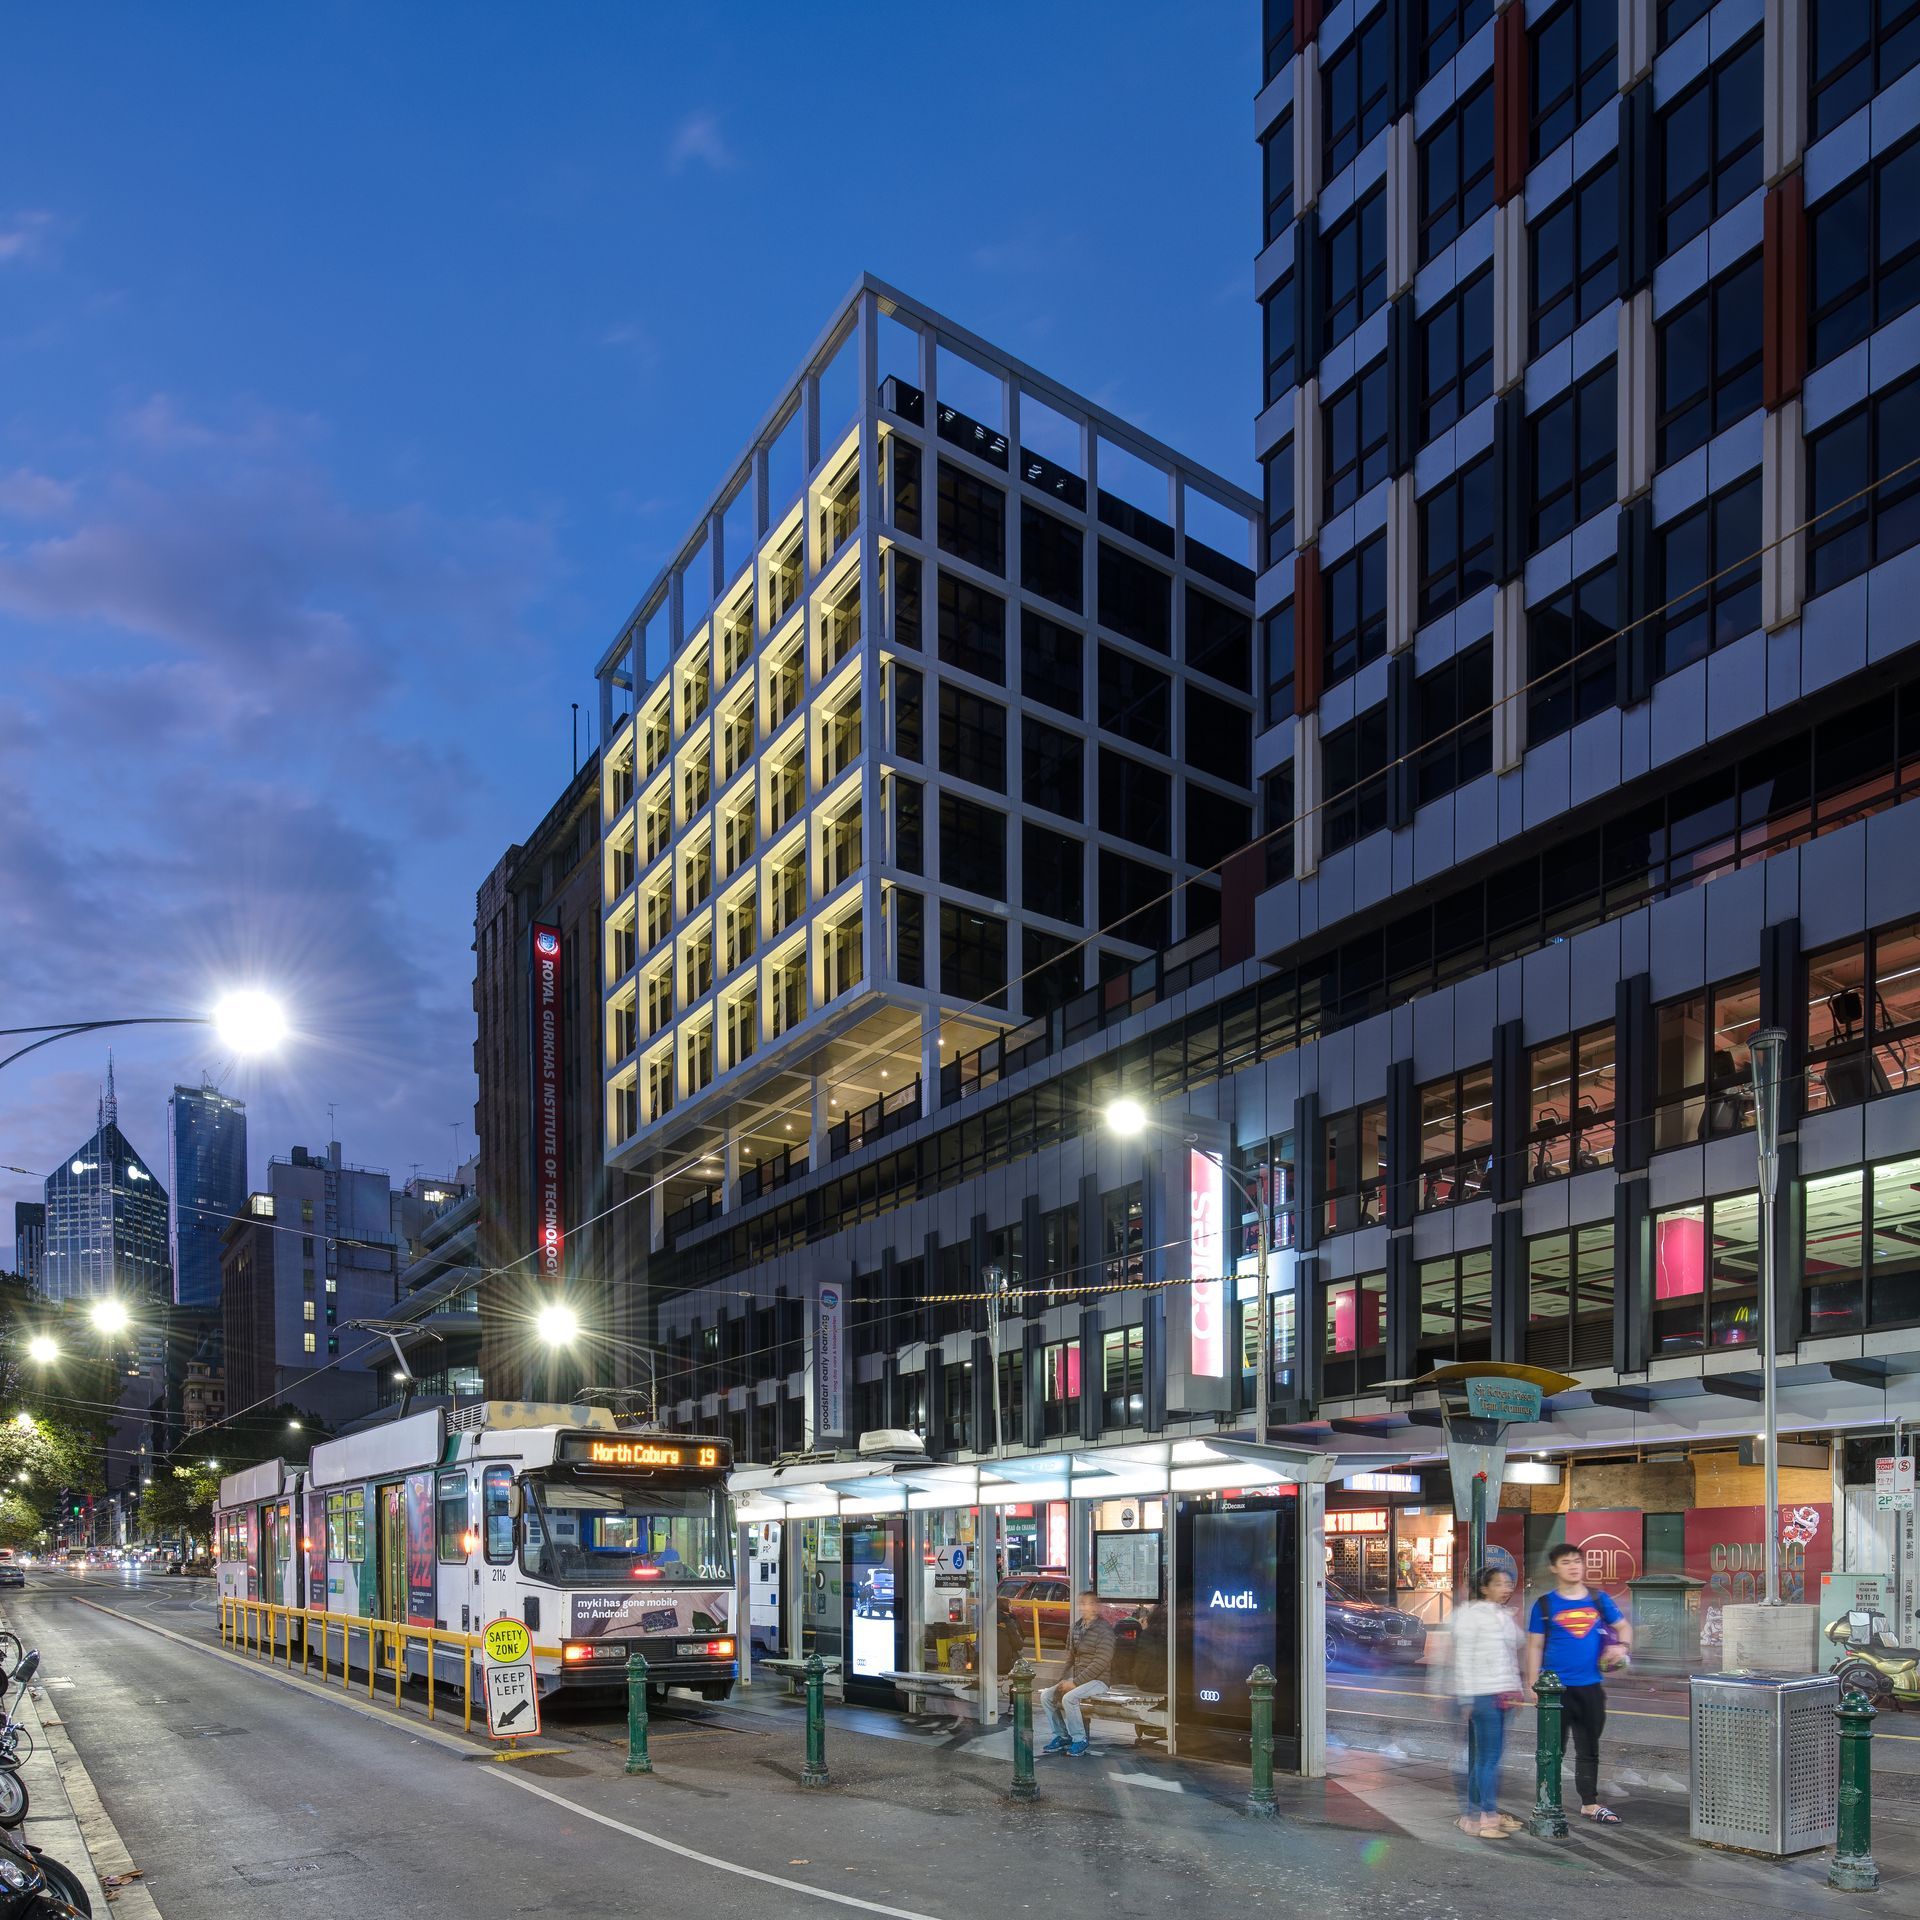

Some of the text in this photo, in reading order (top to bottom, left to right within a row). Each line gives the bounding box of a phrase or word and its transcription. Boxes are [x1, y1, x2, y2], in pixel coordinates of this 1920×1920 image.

[542, 960, 558, 1278] ROYAL GURKHAS INSTITUTE OF TECHNOLOGY
[822, 1314, 830, 1430] goodstart early learning
[593, 1443, 715, 1465] North Coburg 19
[1878, 1496, 1893, 1505] 2P
[492, 1569, 507, 1581] 2116
[698, 1564, 726, 1579] 2116
[577, 1598, 678, 1609] myki has gone mobile
[1210, 1590, 1257, 1609] Audi.
[577, 1609, 629, 1619] on Android
[490, 1630, 523, 1643] SAFETY
[496, 1644, 519, 1655] ZONE
[494, 1672, 525, 1684] KEEP
[497, 1685, 525, 1696] LEFT
